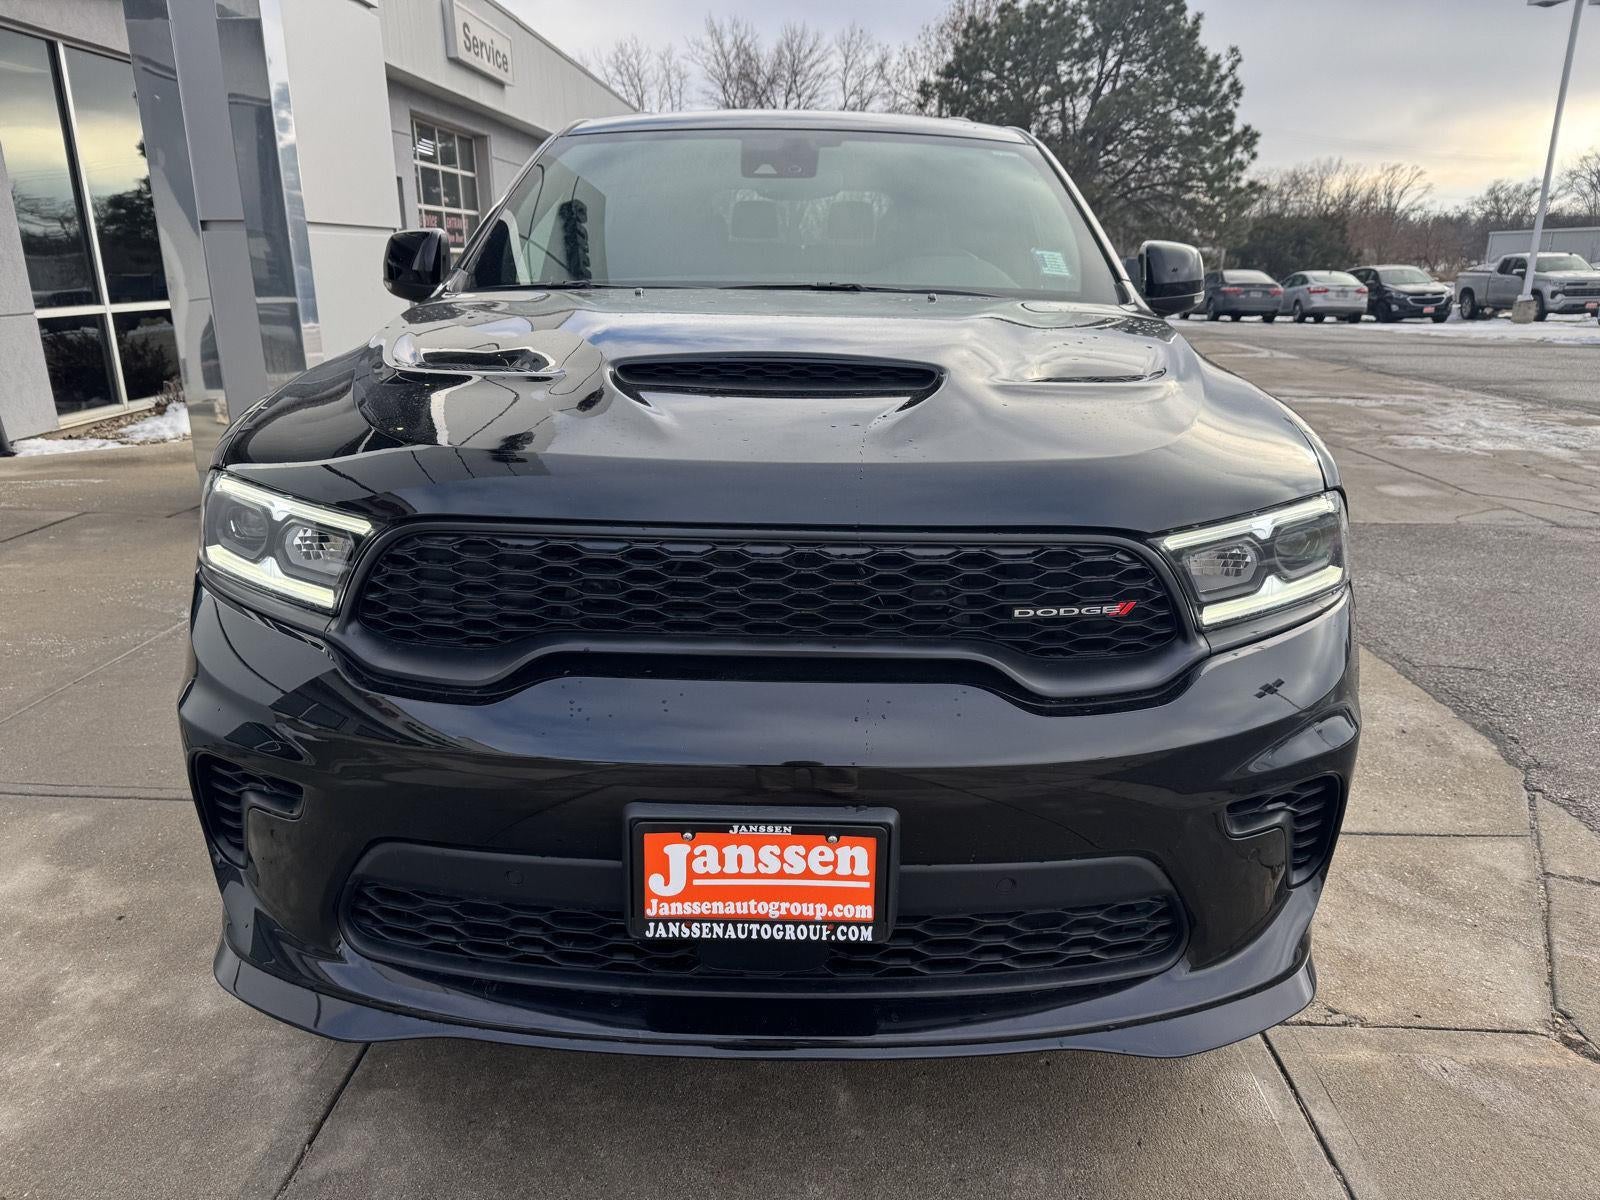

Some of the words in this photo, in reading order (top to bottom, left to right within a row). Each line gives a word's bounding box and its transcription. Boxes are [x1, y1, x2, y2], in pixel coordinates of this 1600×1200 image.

[462, 21, 509, 73] Service
[1014, 605, 1121, 617] DODGE
[728, 825, 792, 835] JANSSEN
[648, 843, 870, 896] Janssen
[646, 898, 873, 920] Janssenautogroup.com
[645, 921, 874, 942] JANSSENAUTOGROUP.COM
